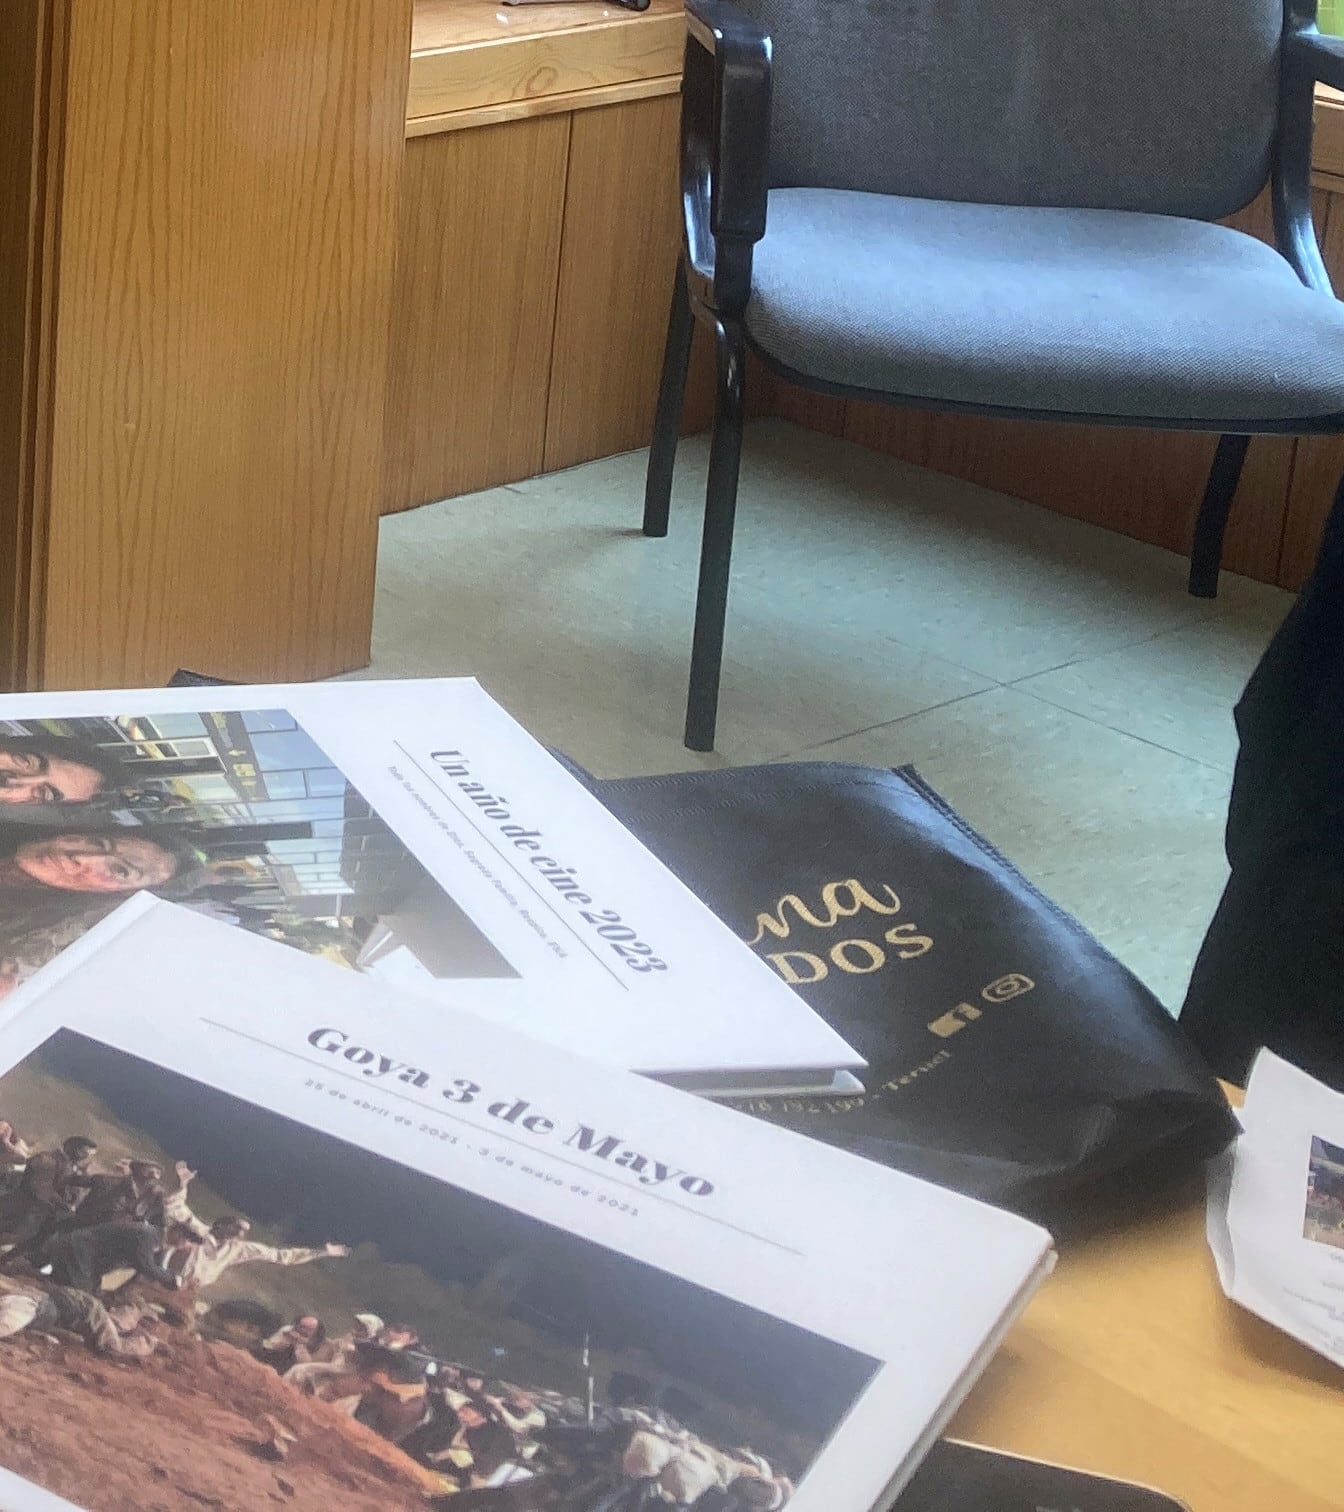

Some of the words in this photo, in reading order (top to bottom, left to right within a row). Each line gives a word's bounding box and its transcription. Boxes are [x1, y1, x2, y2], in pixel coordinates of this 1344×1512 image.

[430, 750, 470, 776] Un
[458, 781, 510, 820] año
[499, 825, 543, 851] de
[530, 855, 593, 905] cine
[578, 909, 669, 973] 2023
[307, 1027, 430, 1089] Goya
[442, 1079, 482, 1104] 3
[487, 1098, 555, 1135] de
[562, 1123, 715, 1197] Mayo
[353, 1098, 390, 1117] abril
[394, 1115, 412, 1127] de
